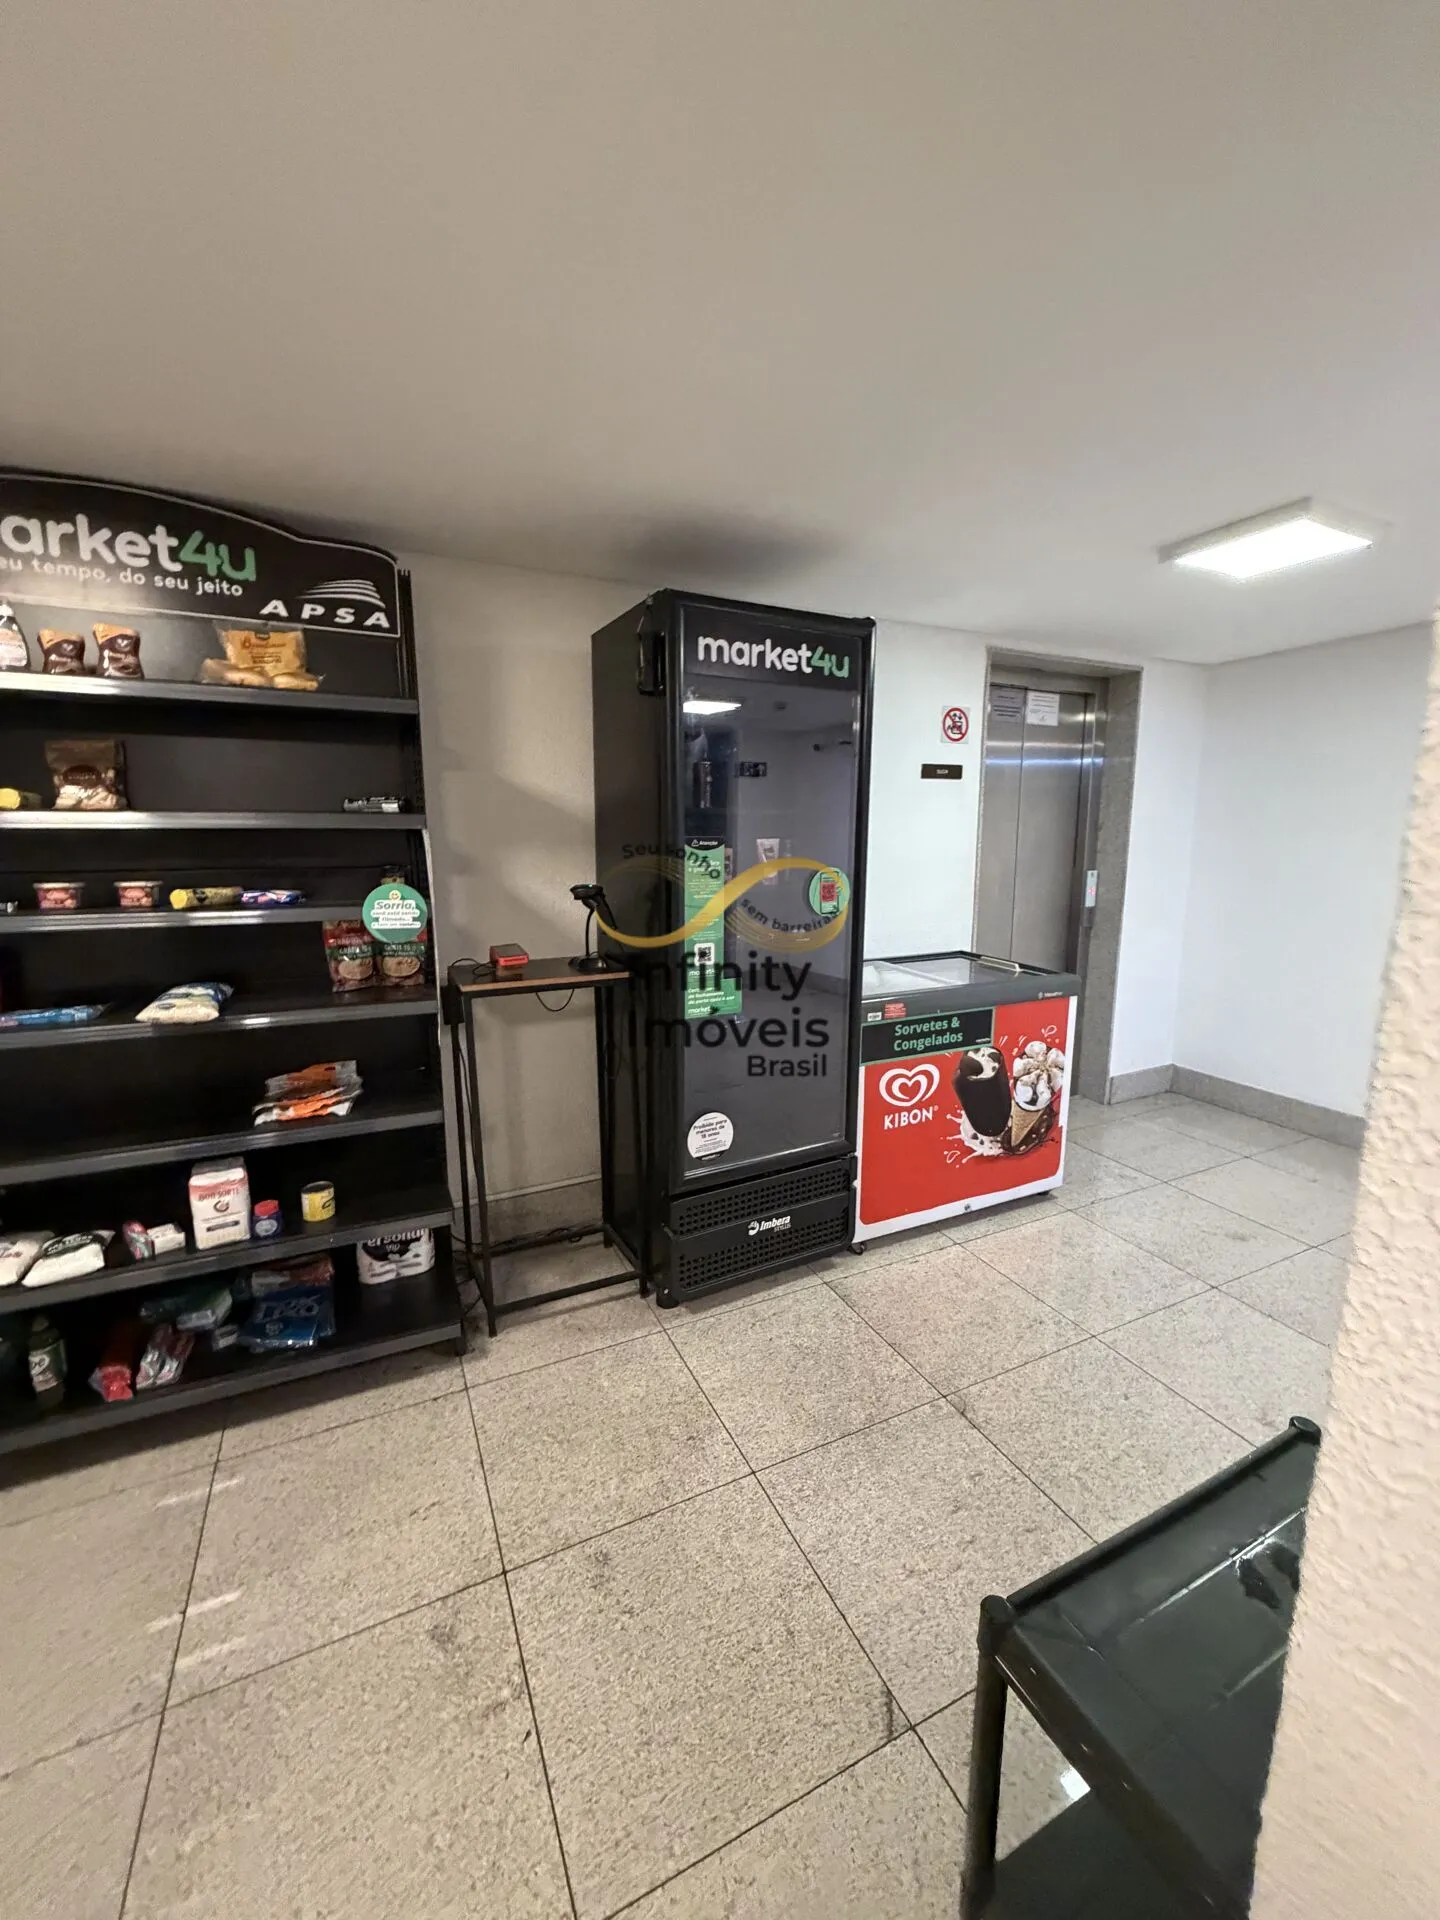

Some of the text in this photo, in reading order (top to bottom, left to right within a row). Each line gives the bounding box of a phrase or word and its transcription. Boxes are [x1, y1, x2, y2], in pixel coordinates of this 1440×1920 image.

[0, 513, 257, 582] arket4u
[0, 556, 243, 596] eu tempo, do seu jeito
[259, 599, 391, 628] APSA
[698, 636, 849, 678] market4u
[894, 1016, 960, 1036] Sorvetes &
[893, 1031, 963, 1051] Congelados
[884, 1106, 933, 1130] KIBON
[760, 1215, 791, 1231] Imbera
